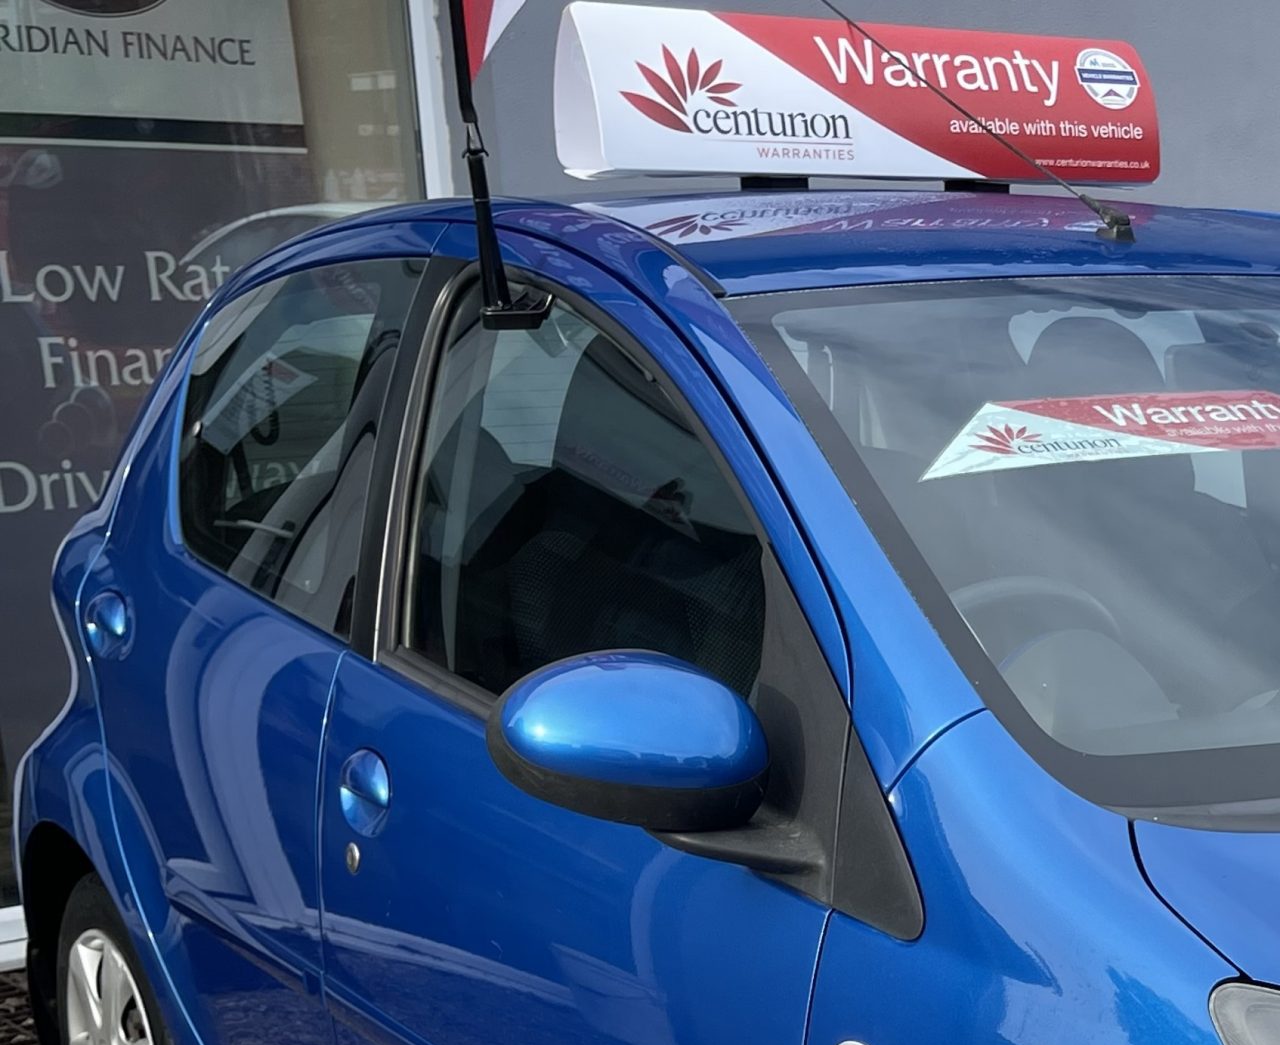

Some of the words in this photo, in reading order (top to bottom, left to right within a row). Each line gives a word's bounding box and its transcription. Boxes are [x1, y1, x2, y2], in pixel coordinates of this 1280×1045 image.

[121, 31, 256, 66] FINANCE
[813, 36, 1059, 107] Warranty
[692, 108, 853, 139] centurion
[950, 117, 1019, 136] available
[1023, 119, 1056, 137] with
[1059, 121, 1088, 138] this
[1091, 124, 1143, 140] vehicle
[756, 147, 855, 161] WARRANTIES
[0, 250, 125, 302] Low
[145, 250, 243, 302] Rat
[1167, 423, 1231, 438] available
[1231, 421, 1264, 435] with
[1017, 437, 1121, 454] centurion
